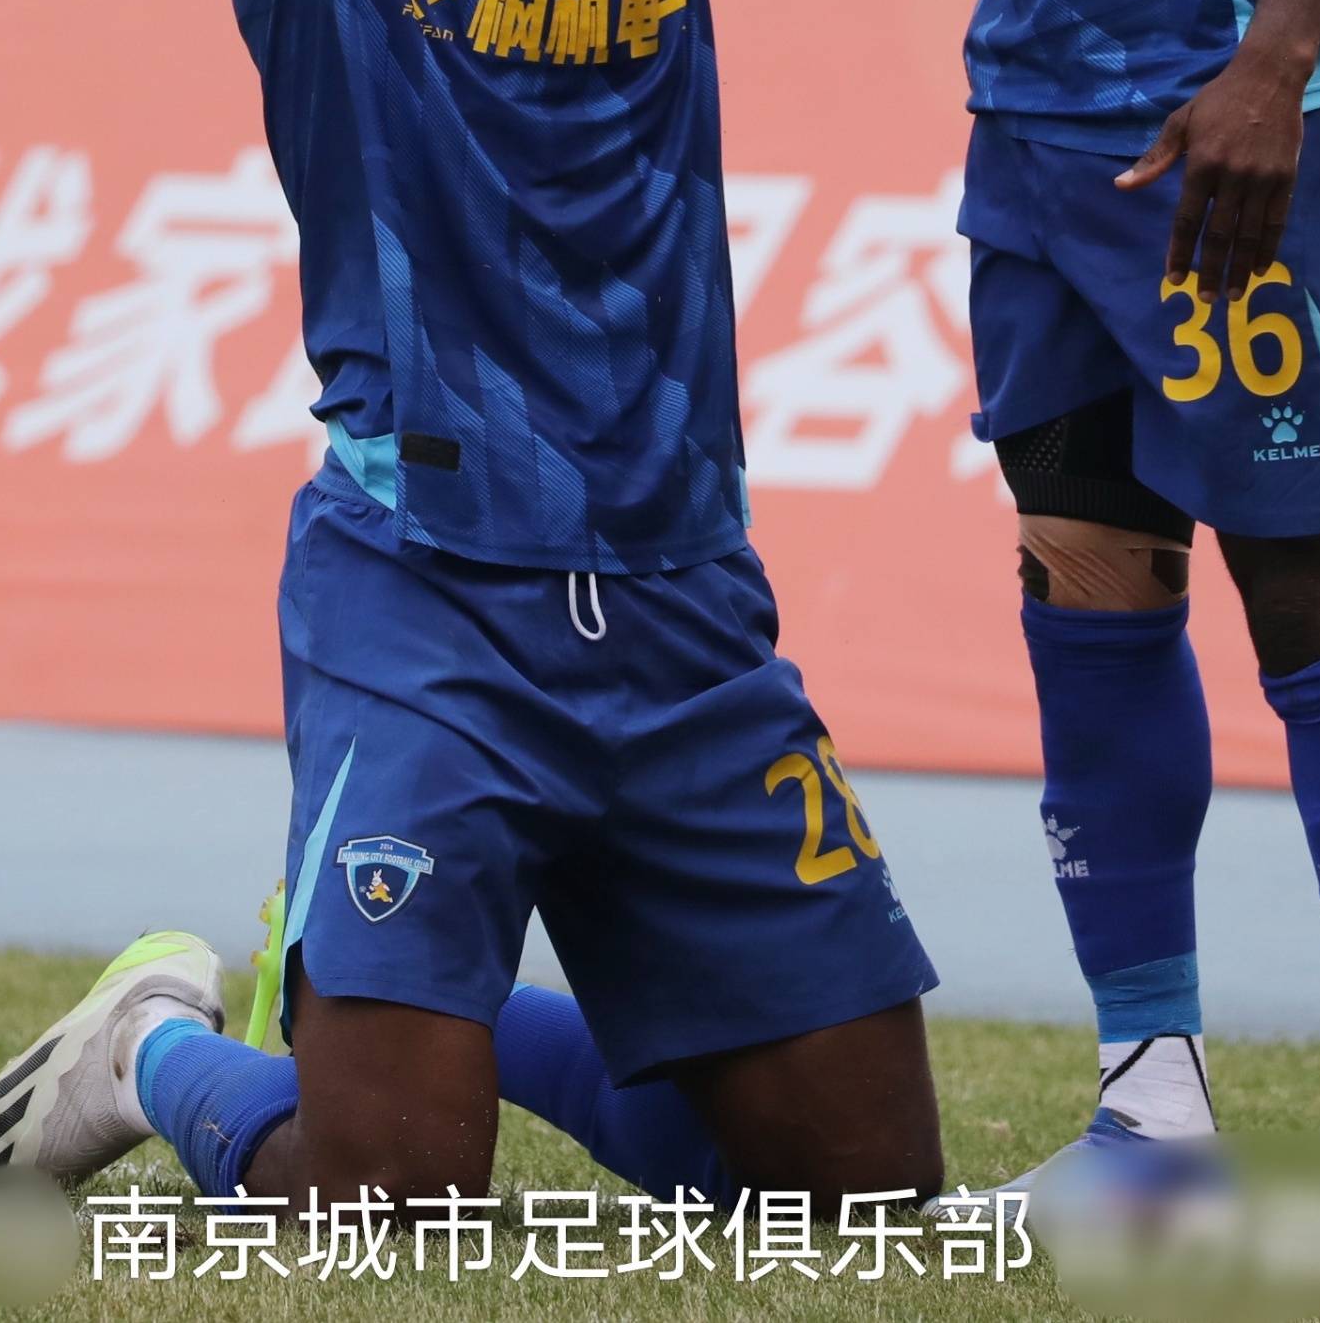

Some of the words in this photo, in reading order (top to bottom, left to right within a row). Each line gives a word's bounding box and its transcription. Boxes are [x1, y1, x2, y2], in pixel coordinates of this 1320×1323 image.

[1160, 261, 1303, 403] 36
[371, 852, 384, 863] CITY
[384, 853, 413, 867] FOOTBALL
[414, 859, 430, 871] CLUB
[765, 736, 880, 885] 28
